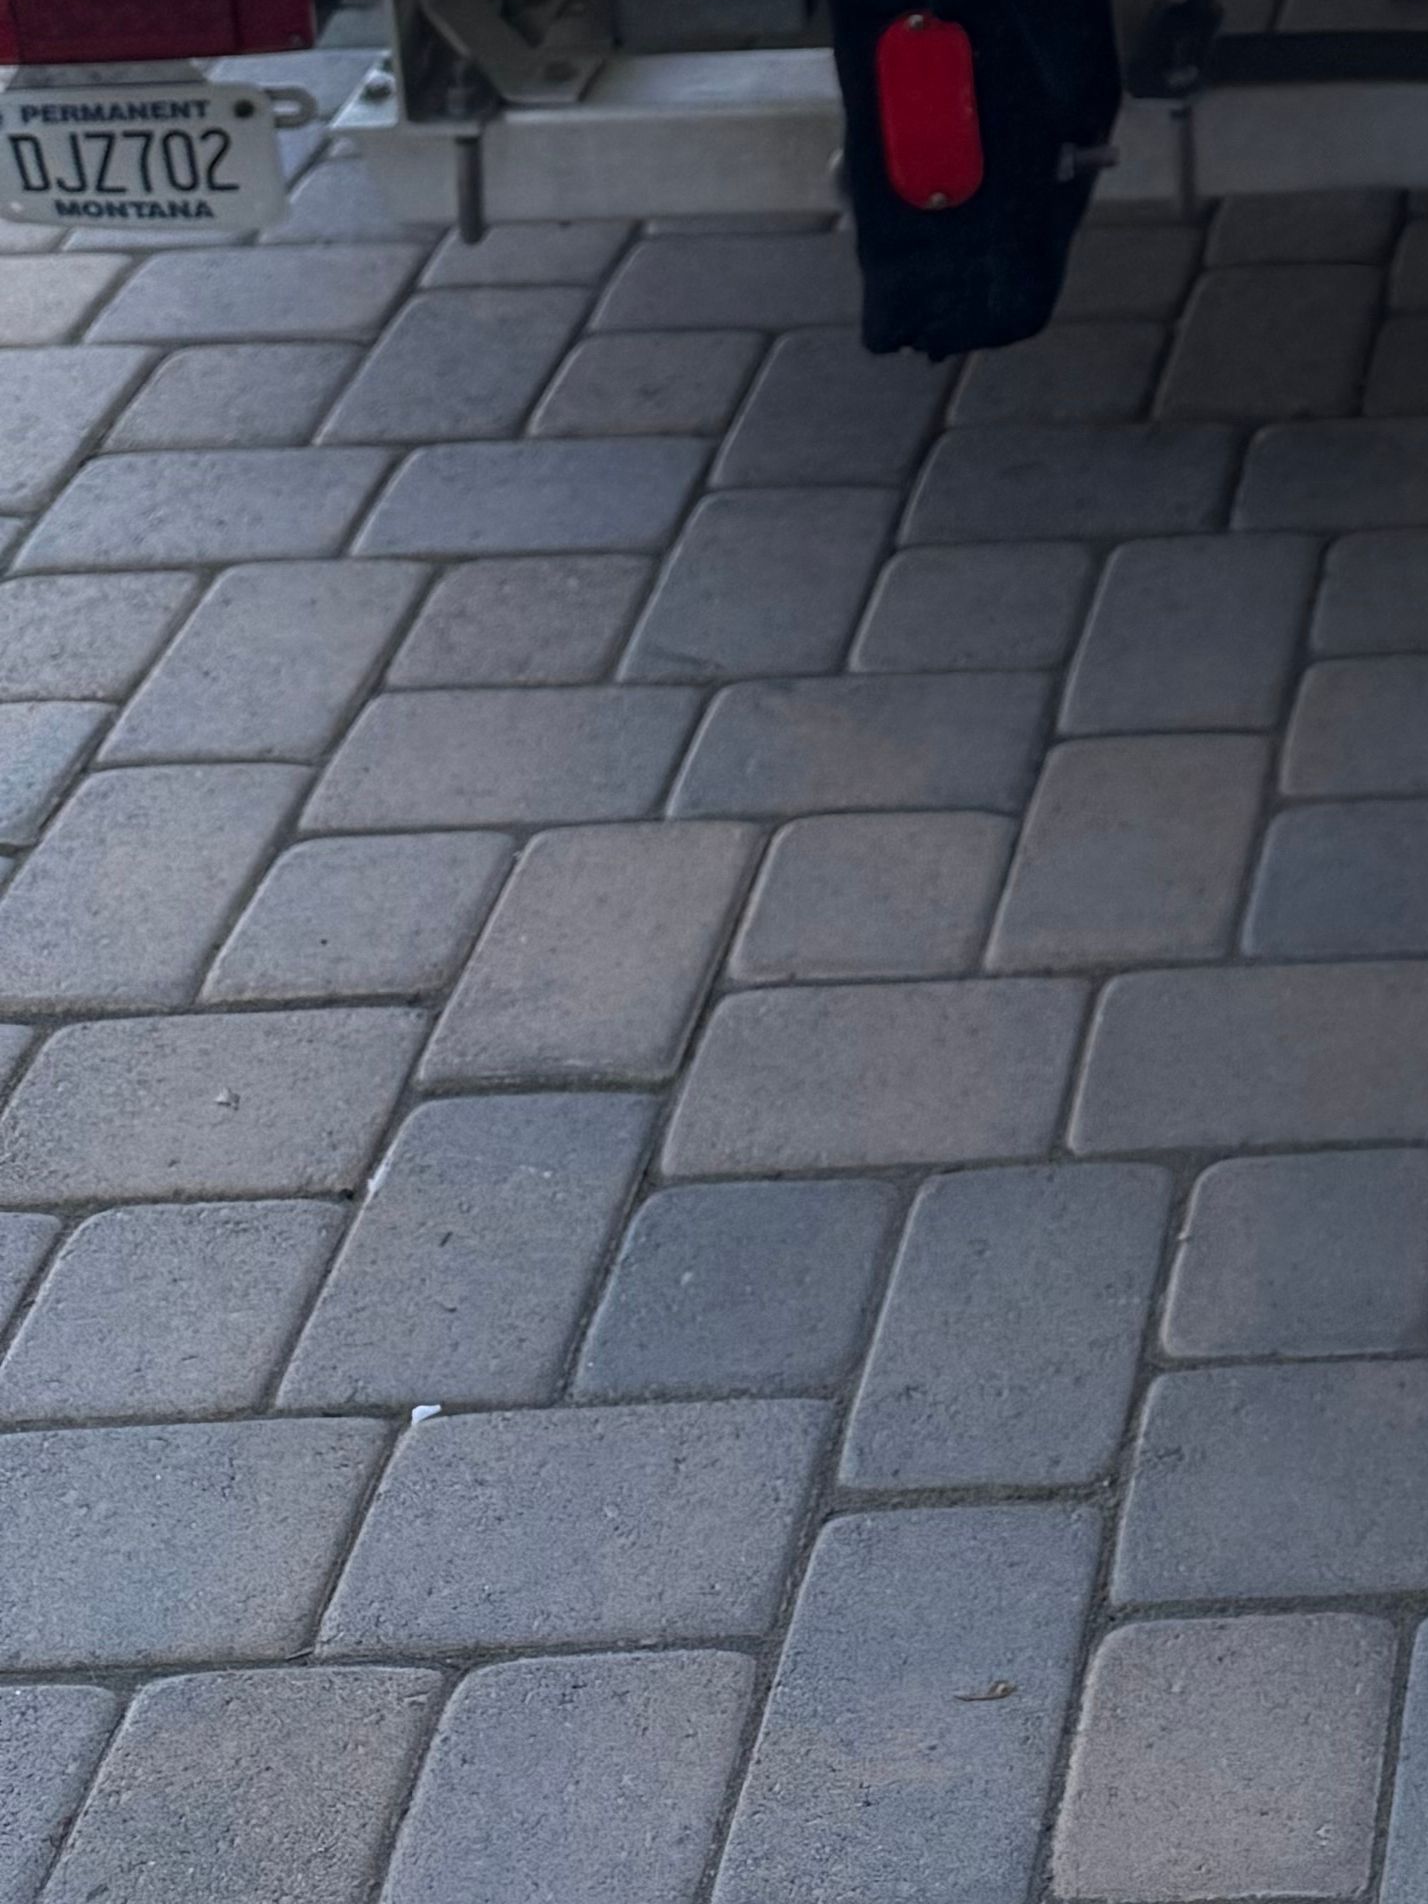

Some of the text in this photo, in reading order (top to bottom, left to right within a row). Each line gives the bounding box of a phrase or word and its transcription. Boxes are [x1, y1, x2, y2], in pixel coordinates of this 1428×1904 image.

[20, 98, 211, 124] PERMANENT
[8, 127, 241, 193] DJZ702
[54, 198, 215, 219] MONTANA
